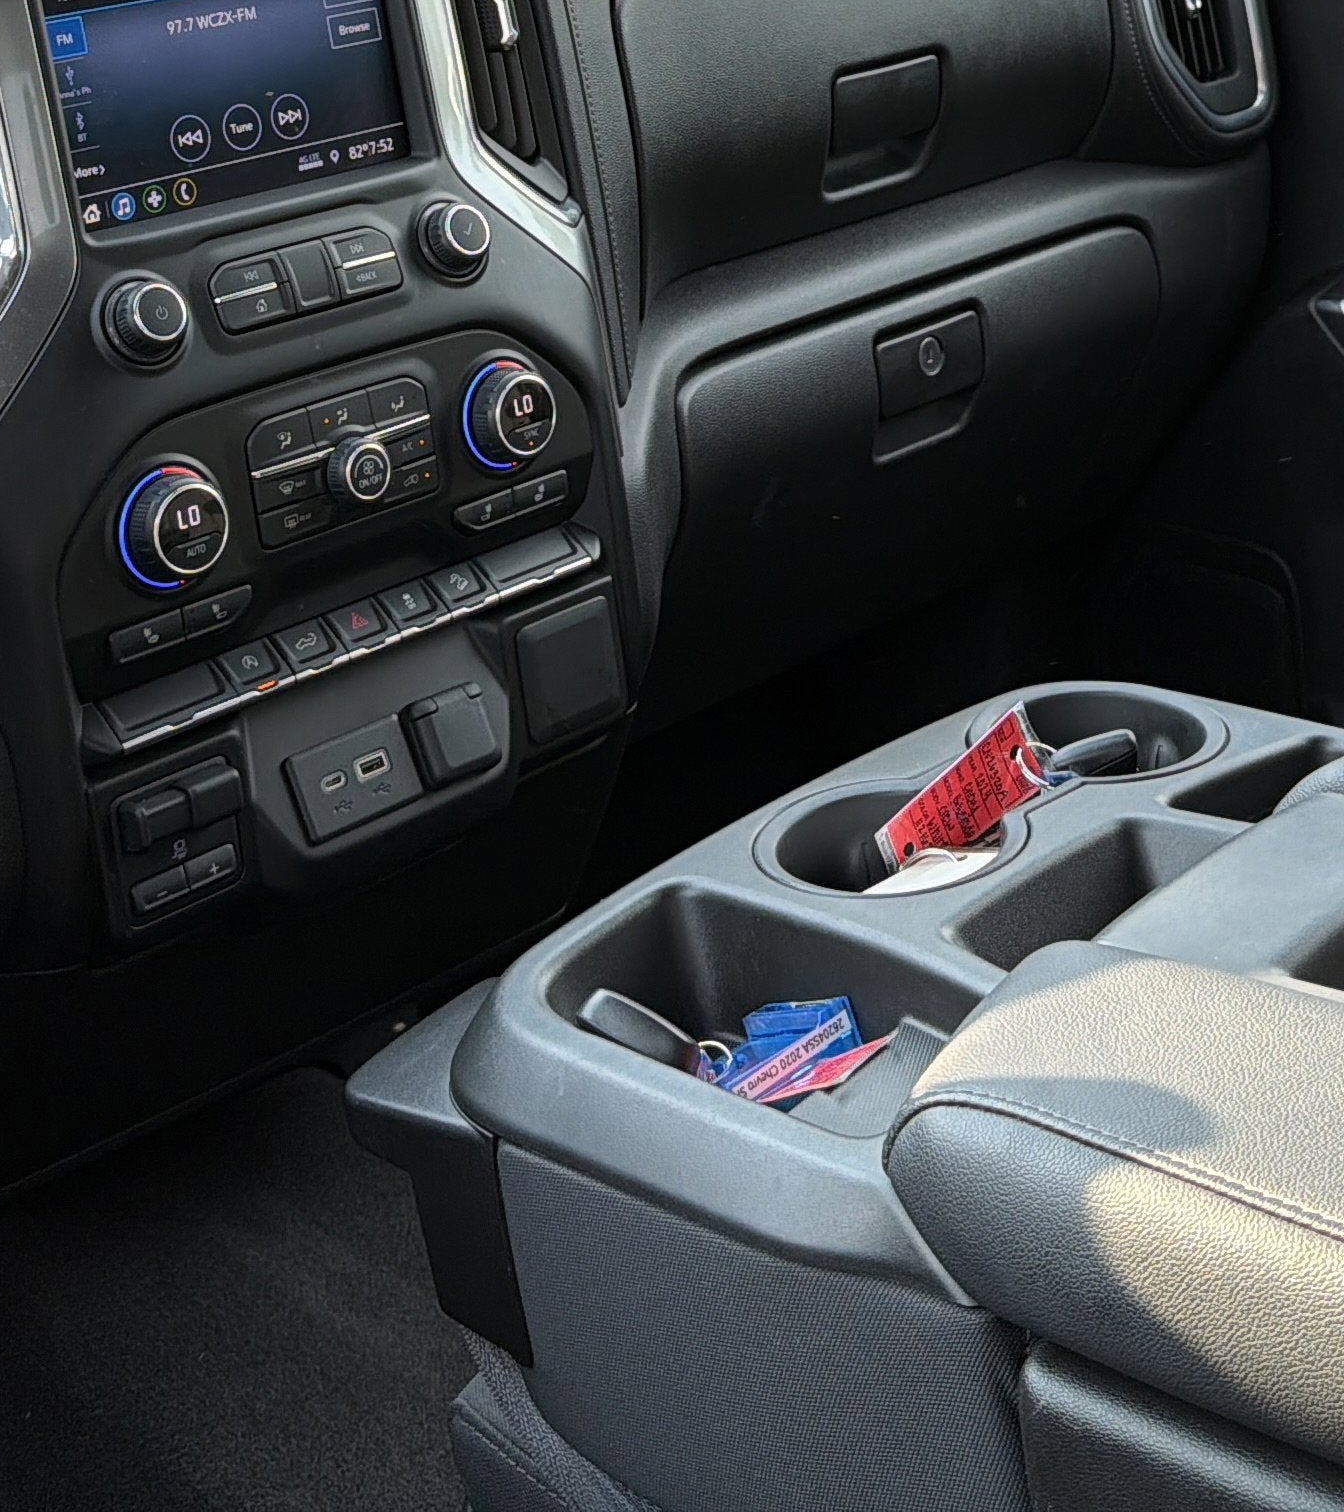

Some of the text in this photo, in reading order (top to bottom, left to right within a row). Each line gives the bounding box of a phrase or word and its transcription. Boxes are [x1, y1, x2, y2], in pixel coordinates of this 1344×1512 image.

[166, 6, 258, 35] 97.7 WCZX-FM
[338, 21, 371, 36] Browse
[56, 32, 74, 46] FM
[229, 121, 254, 135] Tune
[77, 132, 87, 143] BT
[368, 137, 395, 156] 7:52
[513, 394, 534, 417] LO
[359, 473, 383, 489] ON/OFF
[177, 504, 201, 530] LO
[186, 543, 207, 559] AUTO
[780, 1052, 803, 1070] 2020
[747, 1064, 779, 1091] Chevro
